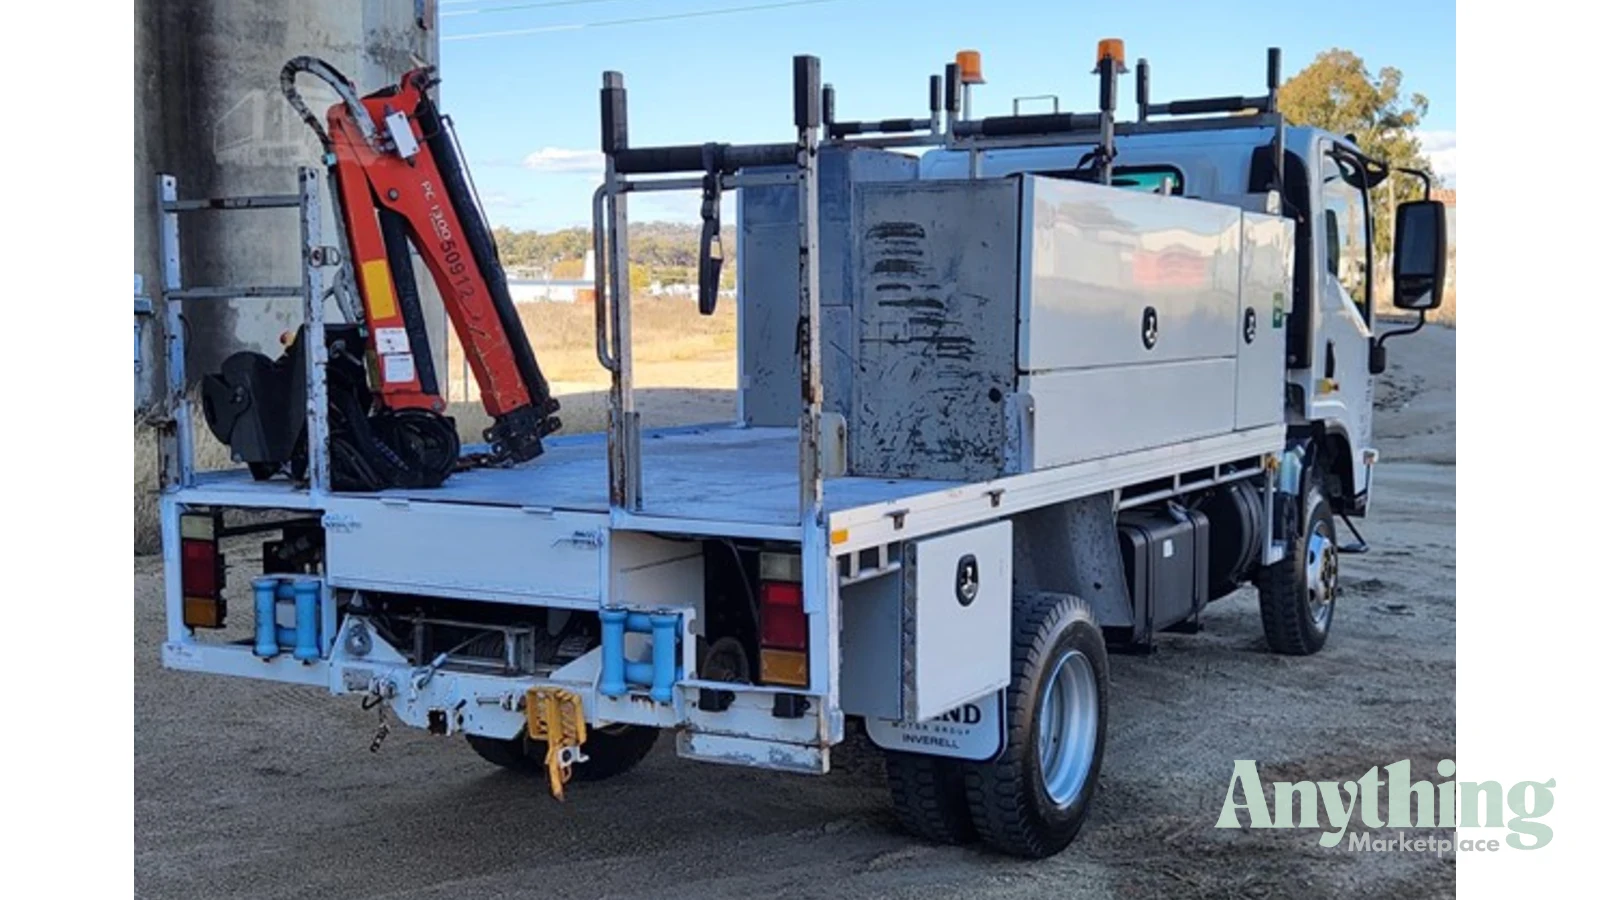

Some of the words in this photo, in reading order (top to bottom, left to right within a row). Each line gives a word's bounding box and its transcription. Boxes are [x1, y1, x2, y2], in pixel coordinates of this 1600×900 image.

[421, 180, 436, 200] PC
[440, 239, 475, 298] 50912
[902, 733, 961, 749] INVERELL
